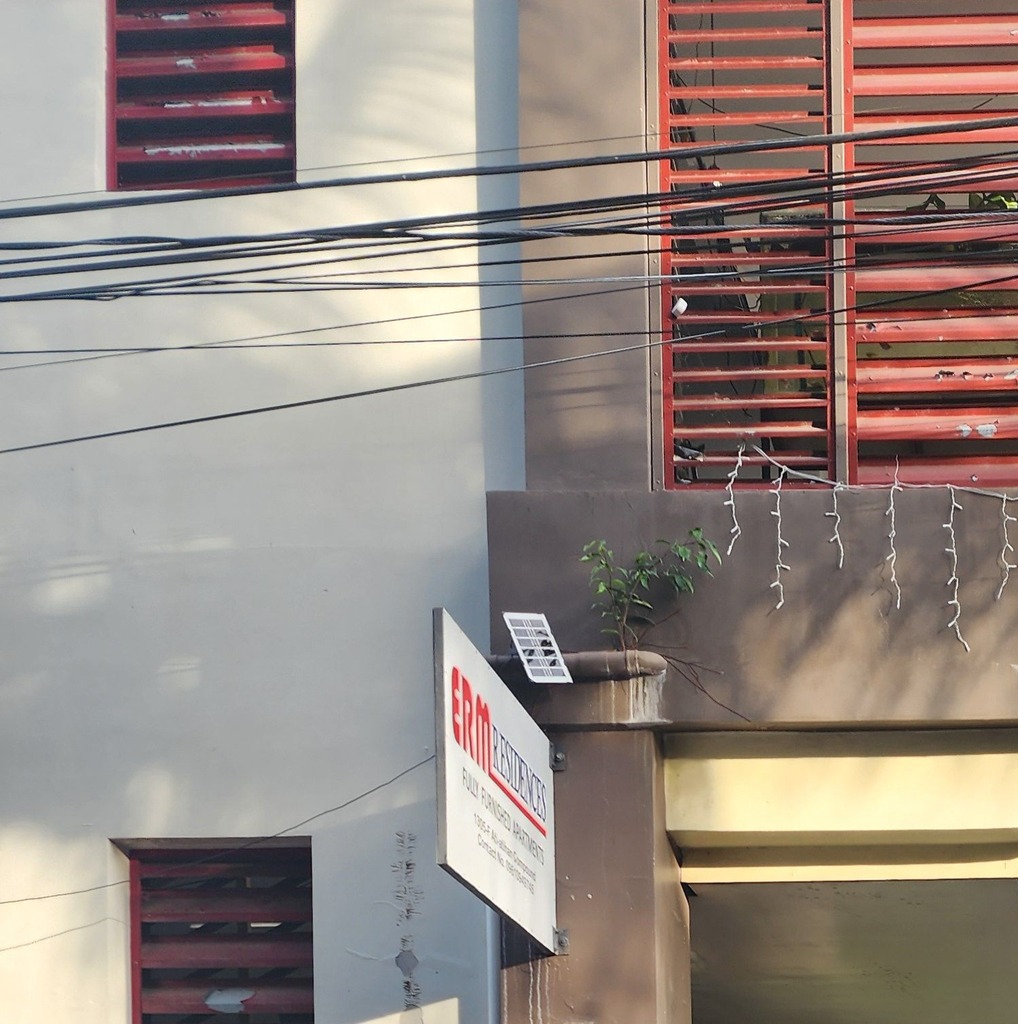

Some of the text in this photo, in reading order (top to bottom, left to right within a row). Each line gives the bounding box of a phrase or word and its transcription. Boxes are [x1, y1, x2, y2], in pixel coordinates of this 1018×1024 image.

[451, 665, 547, 823] ERM RESIDENCES
[462, 766, 544, 867] FULLY FURNISHED APARTMENTS
